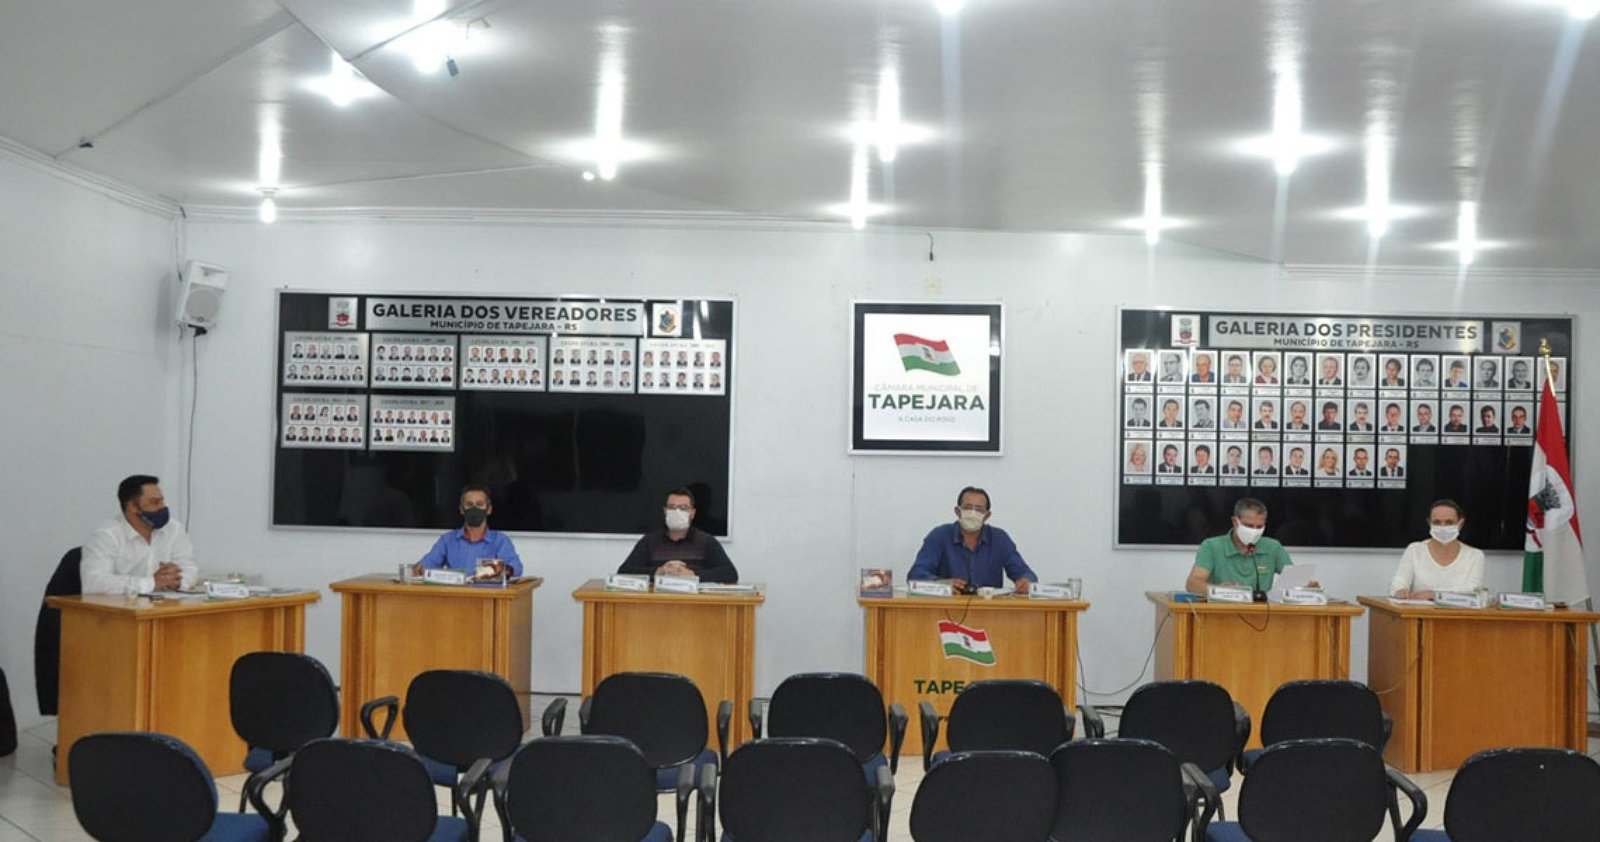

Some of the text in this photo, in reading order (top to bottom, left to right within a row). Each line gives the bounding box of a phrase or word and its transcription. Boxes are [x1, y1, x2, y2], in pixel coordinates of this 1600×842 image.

[372, 302, 637, 323] GALERIA DOS VEREADORES
[430, 319, 485, 330] MUNICÍPIO
[486, 321, 501, 331] DE
[502, 322, 556, 332] TAPEJARA
[564, 323, 578, 332] RS
[1215, 320, 1478, 340] GALERIA DOS PRESIDENTES
[1273, 336, 1328, 347] MUNICÍPIO
[1329, 339, 1343, 348] DE
[1345, 340, 1398, 349] TAPEJARA
[1405, 341, 1420, 350] RS
[915, 384, 962, 393] MUNICIPAL
[966, 385, 977, 393] DE
[868, 393, 985, 411] TAPEJARA
[914, 680, 963, 694] TAPE
